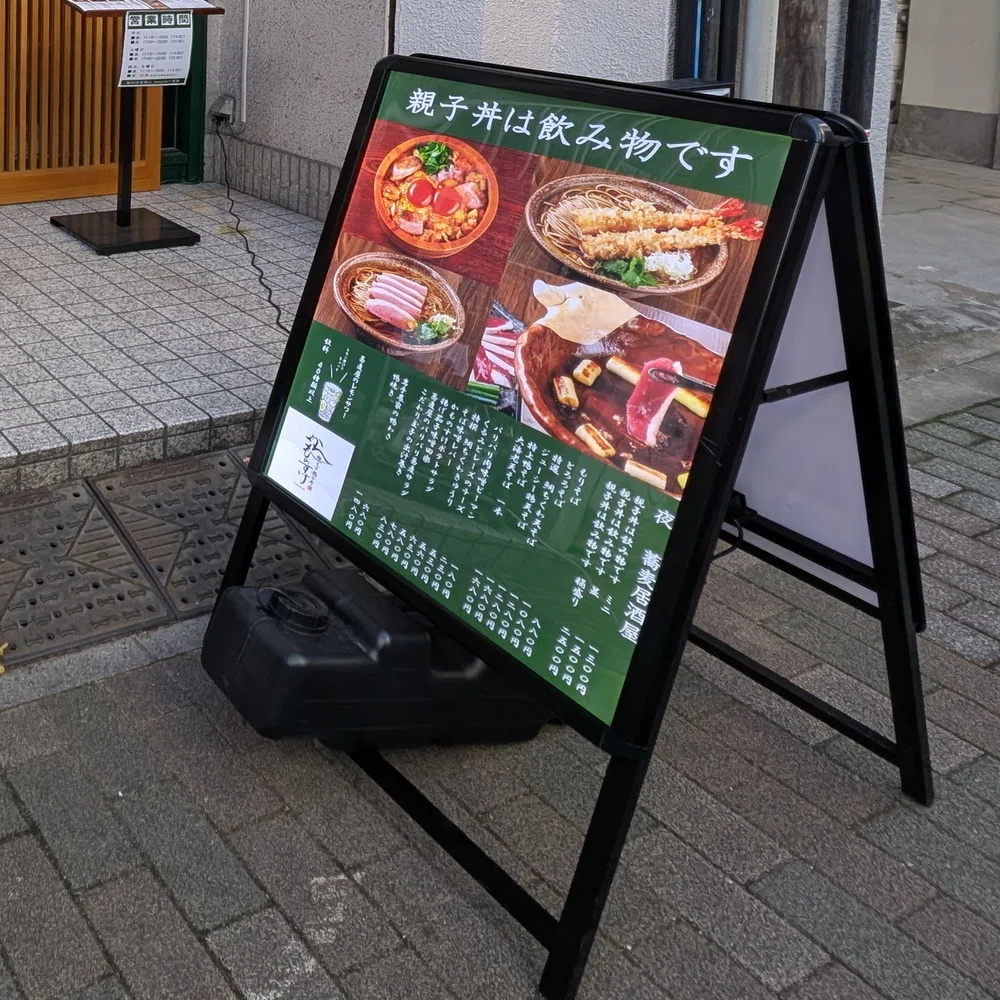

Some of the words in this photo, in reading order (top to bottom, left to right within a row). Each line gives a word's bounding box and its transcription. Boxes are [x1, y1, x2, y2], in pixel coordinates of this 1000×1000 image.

[130, 15, 190, 25] 営業時間
[405, 87, 753, 179] 親子丼は飲み物です
[501, 435, 524, 489] 大海老天そば
[516, 441, 537, 487] 特上鴨そば
[553, 460, 574, 508] とろろそば
[493, 498, 505, 516] 一本
[569, 468, 587, 506] もりそば
[581, 480, 617, 567] 親子丼は飲み物です
[594, 487, 631, 575] 親子丼は飲み物です
[609, 495, 645, 584] 親子丼は飲み物です
[653, 508, 675, 530] 夜
[588, 584, 600, 599] 並
[600, 594, 612, 615] ミニ
[618, 548, 662, 644] 蕎麦居酒屋
